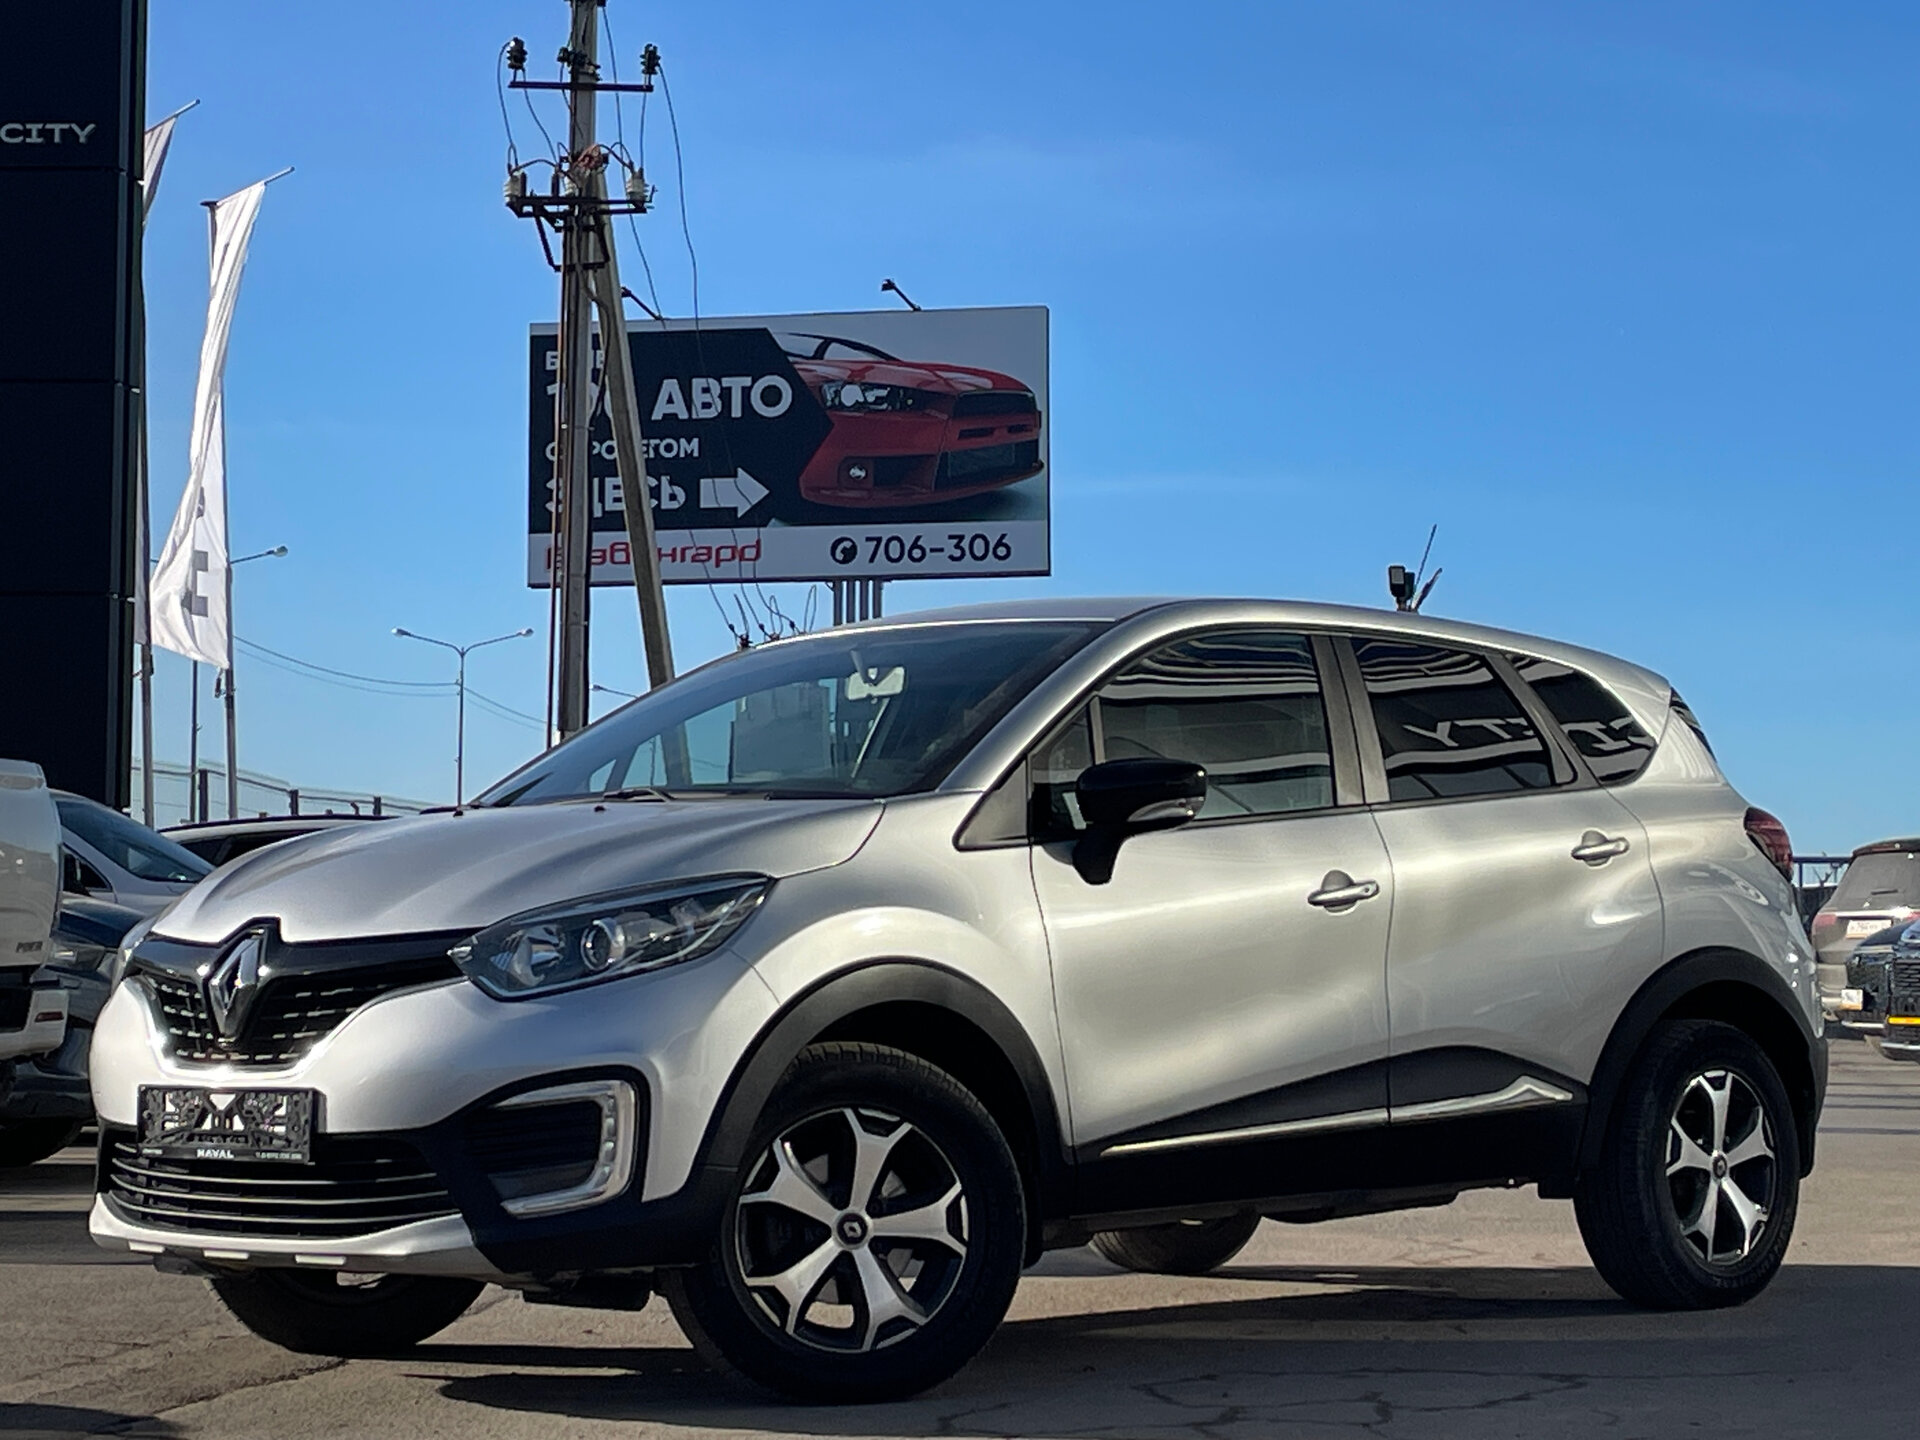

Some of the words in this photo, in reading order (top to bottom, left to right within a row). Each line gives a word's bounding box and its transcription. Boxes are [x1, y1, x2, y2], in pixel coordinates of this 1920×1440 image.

[0, 123, 96, 143] CITY
[651, 375, 793, 420] АВТО
[865, 533, 1012, 563] 706-306
